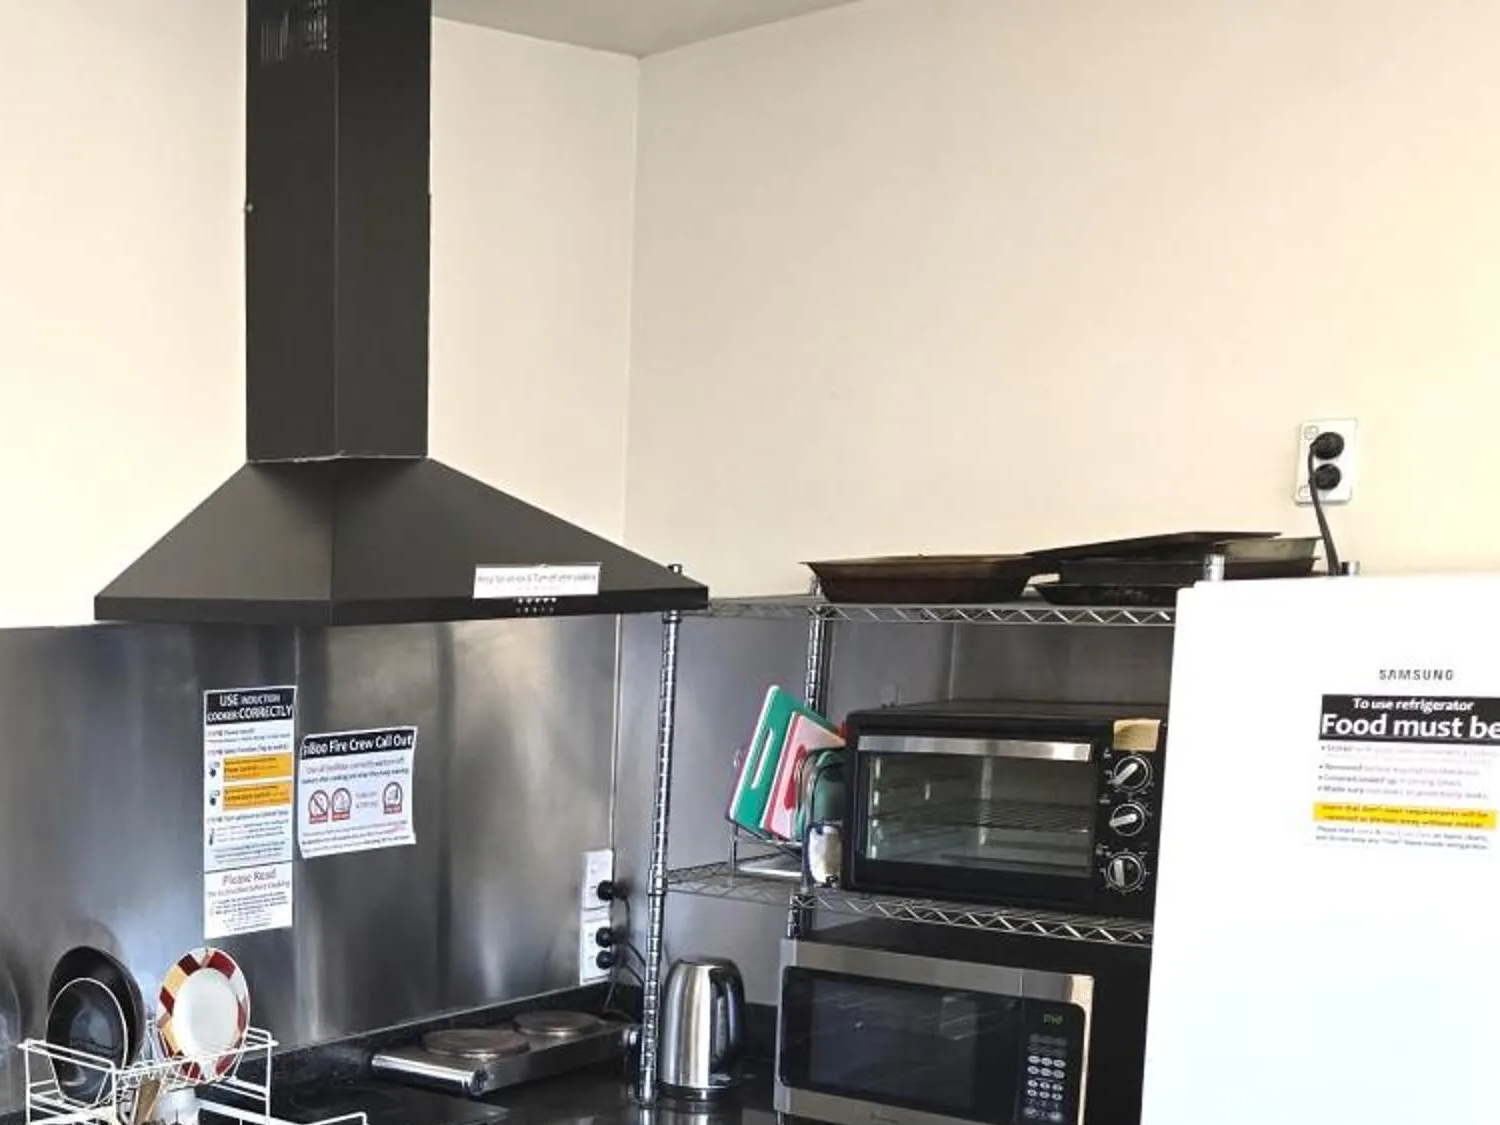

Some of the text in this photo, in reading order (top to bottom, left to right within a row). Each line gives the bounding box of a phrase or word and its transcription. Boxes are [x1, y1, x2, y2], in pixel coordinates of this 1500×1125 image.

[1379, 669, 1454, 681] SAMSUNG
[220, 693, 239, 707] USE
[1353, 697, 1475, 714] To use refrigerator
[239, 704, 293, 720] CORRECTLY
[1321, 712, 1500, 739] Food must be
